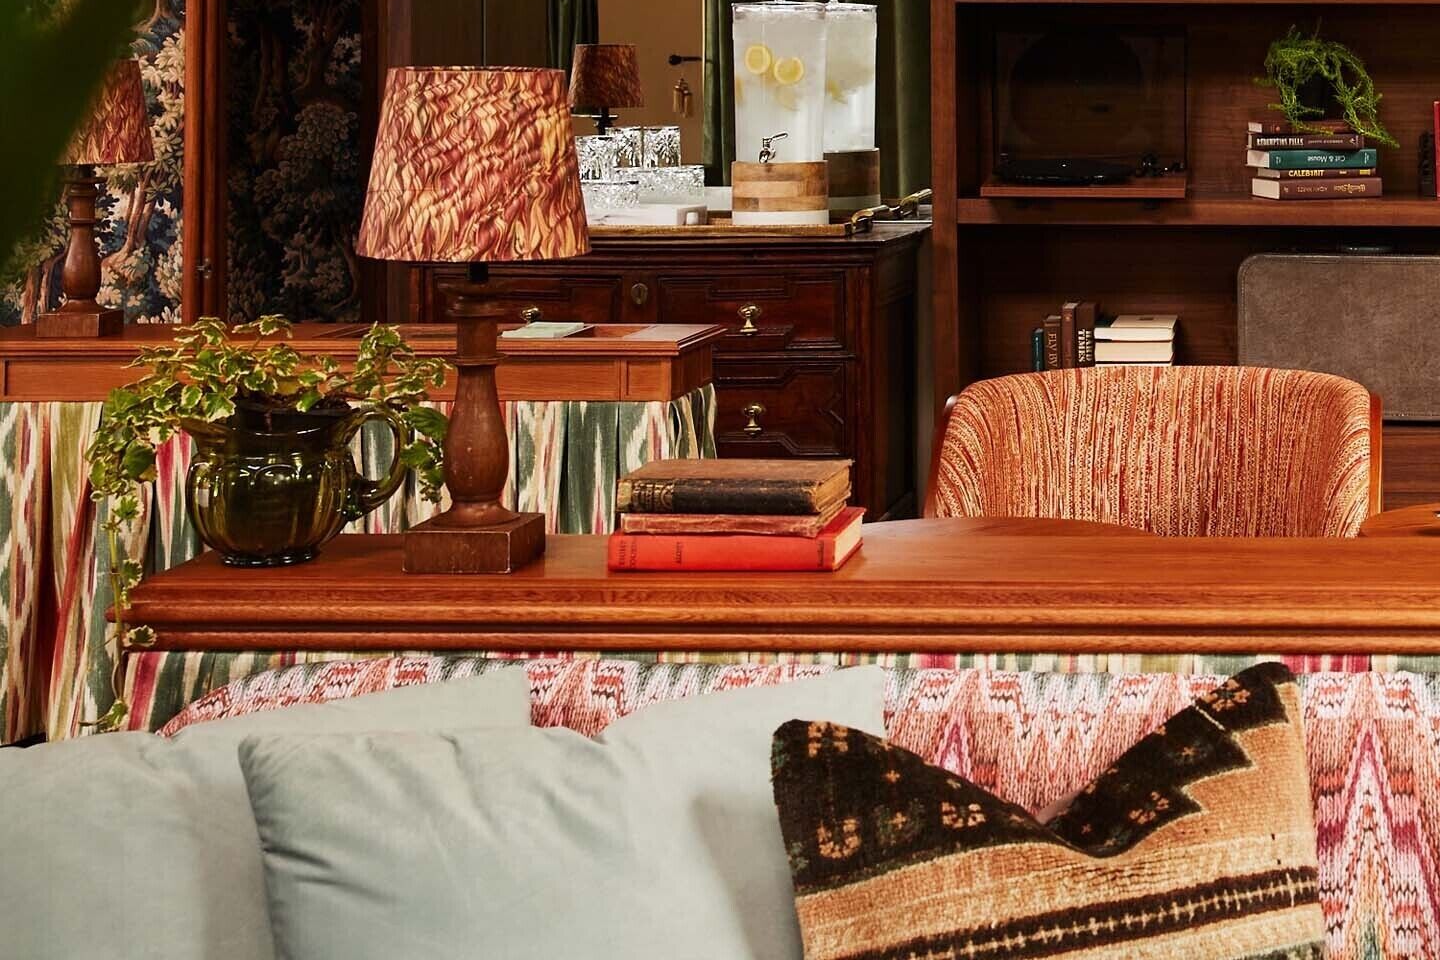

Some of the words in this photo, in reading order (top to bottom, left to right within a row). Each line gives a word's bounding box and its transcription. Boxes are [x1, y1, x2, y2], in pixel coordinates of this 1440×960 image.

[1307, 155, 1328, 163] Mouse
[1047, 333, 1057, 351] FLY
[1077, 329, 1086, 363] TIMES
[1047, 352, 1058, 368] BY
